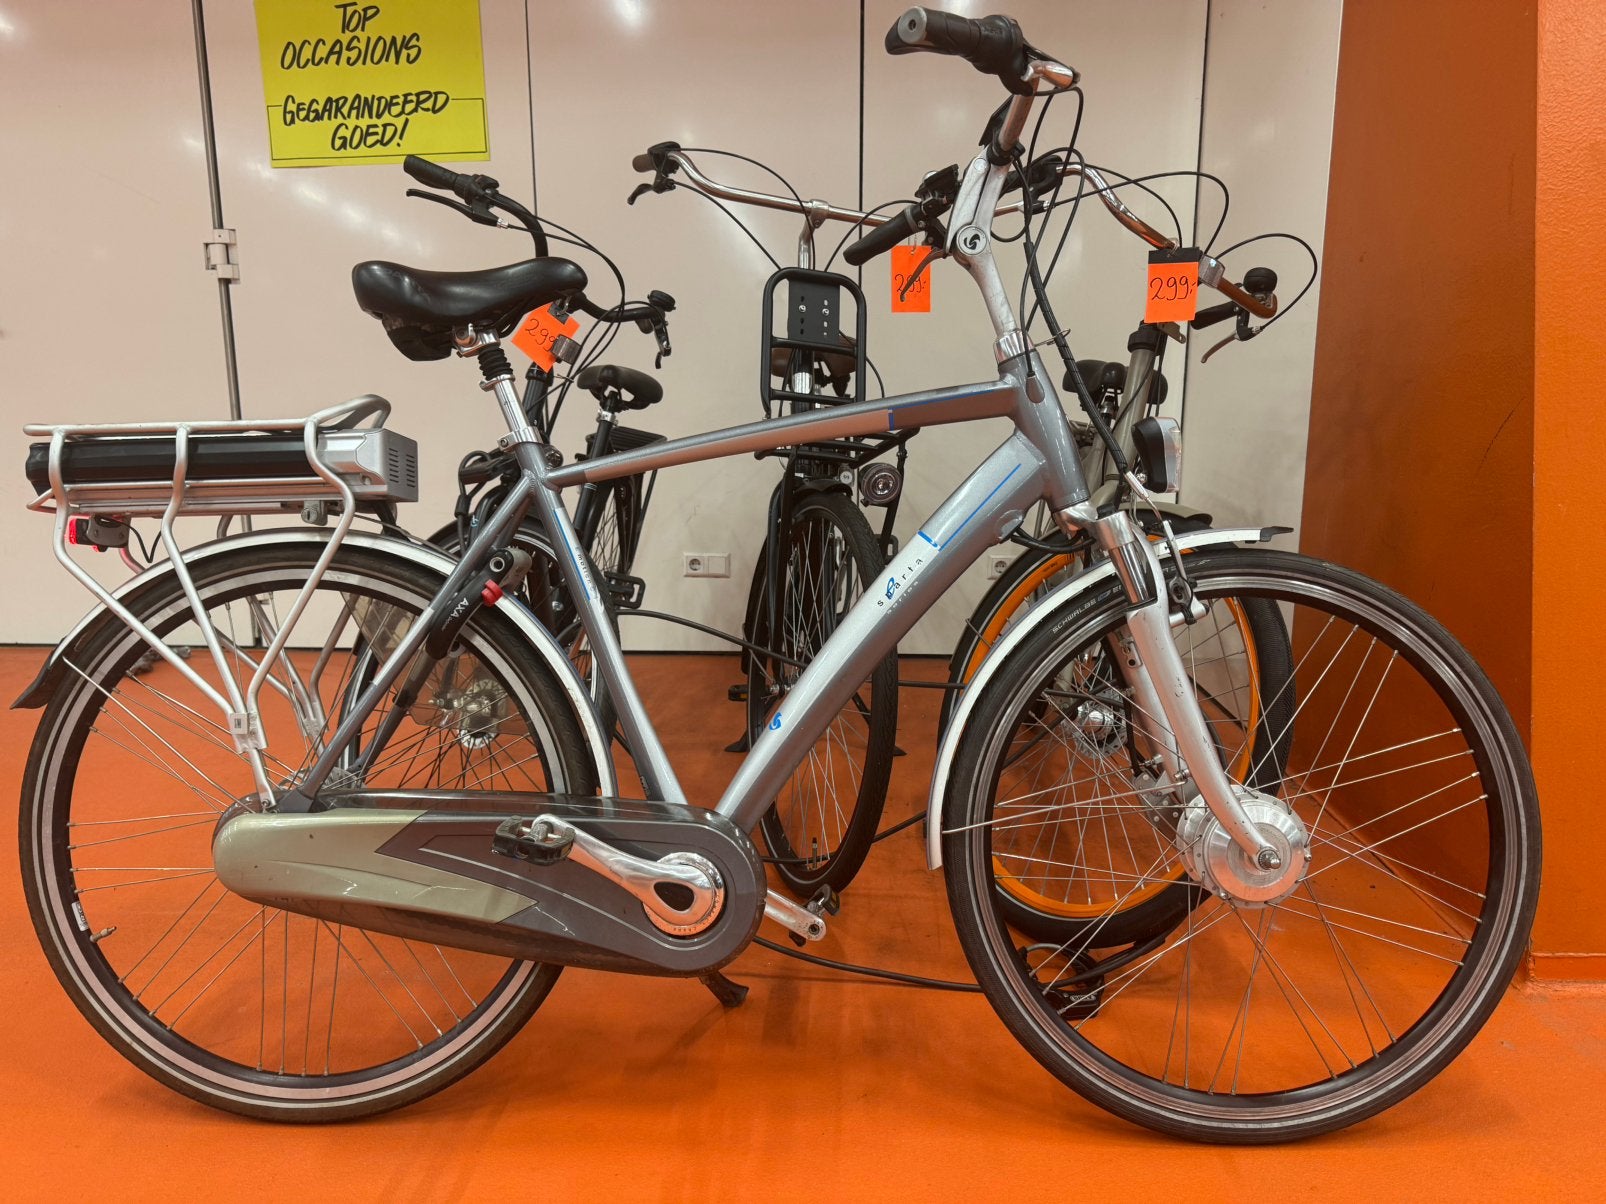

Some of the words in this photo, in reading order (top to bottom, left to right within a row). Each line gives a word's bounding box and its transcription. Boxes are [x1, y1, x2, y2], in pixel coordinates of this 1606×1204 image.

[334, 1, 381, 34] TOP
[280, 32, 422, 70] OCCASIONS
[282, 90, 450, 126] GEGARANDEERD
[331, 117, 410, 151] GOED!
[450, 597, 470, 618] AXA
